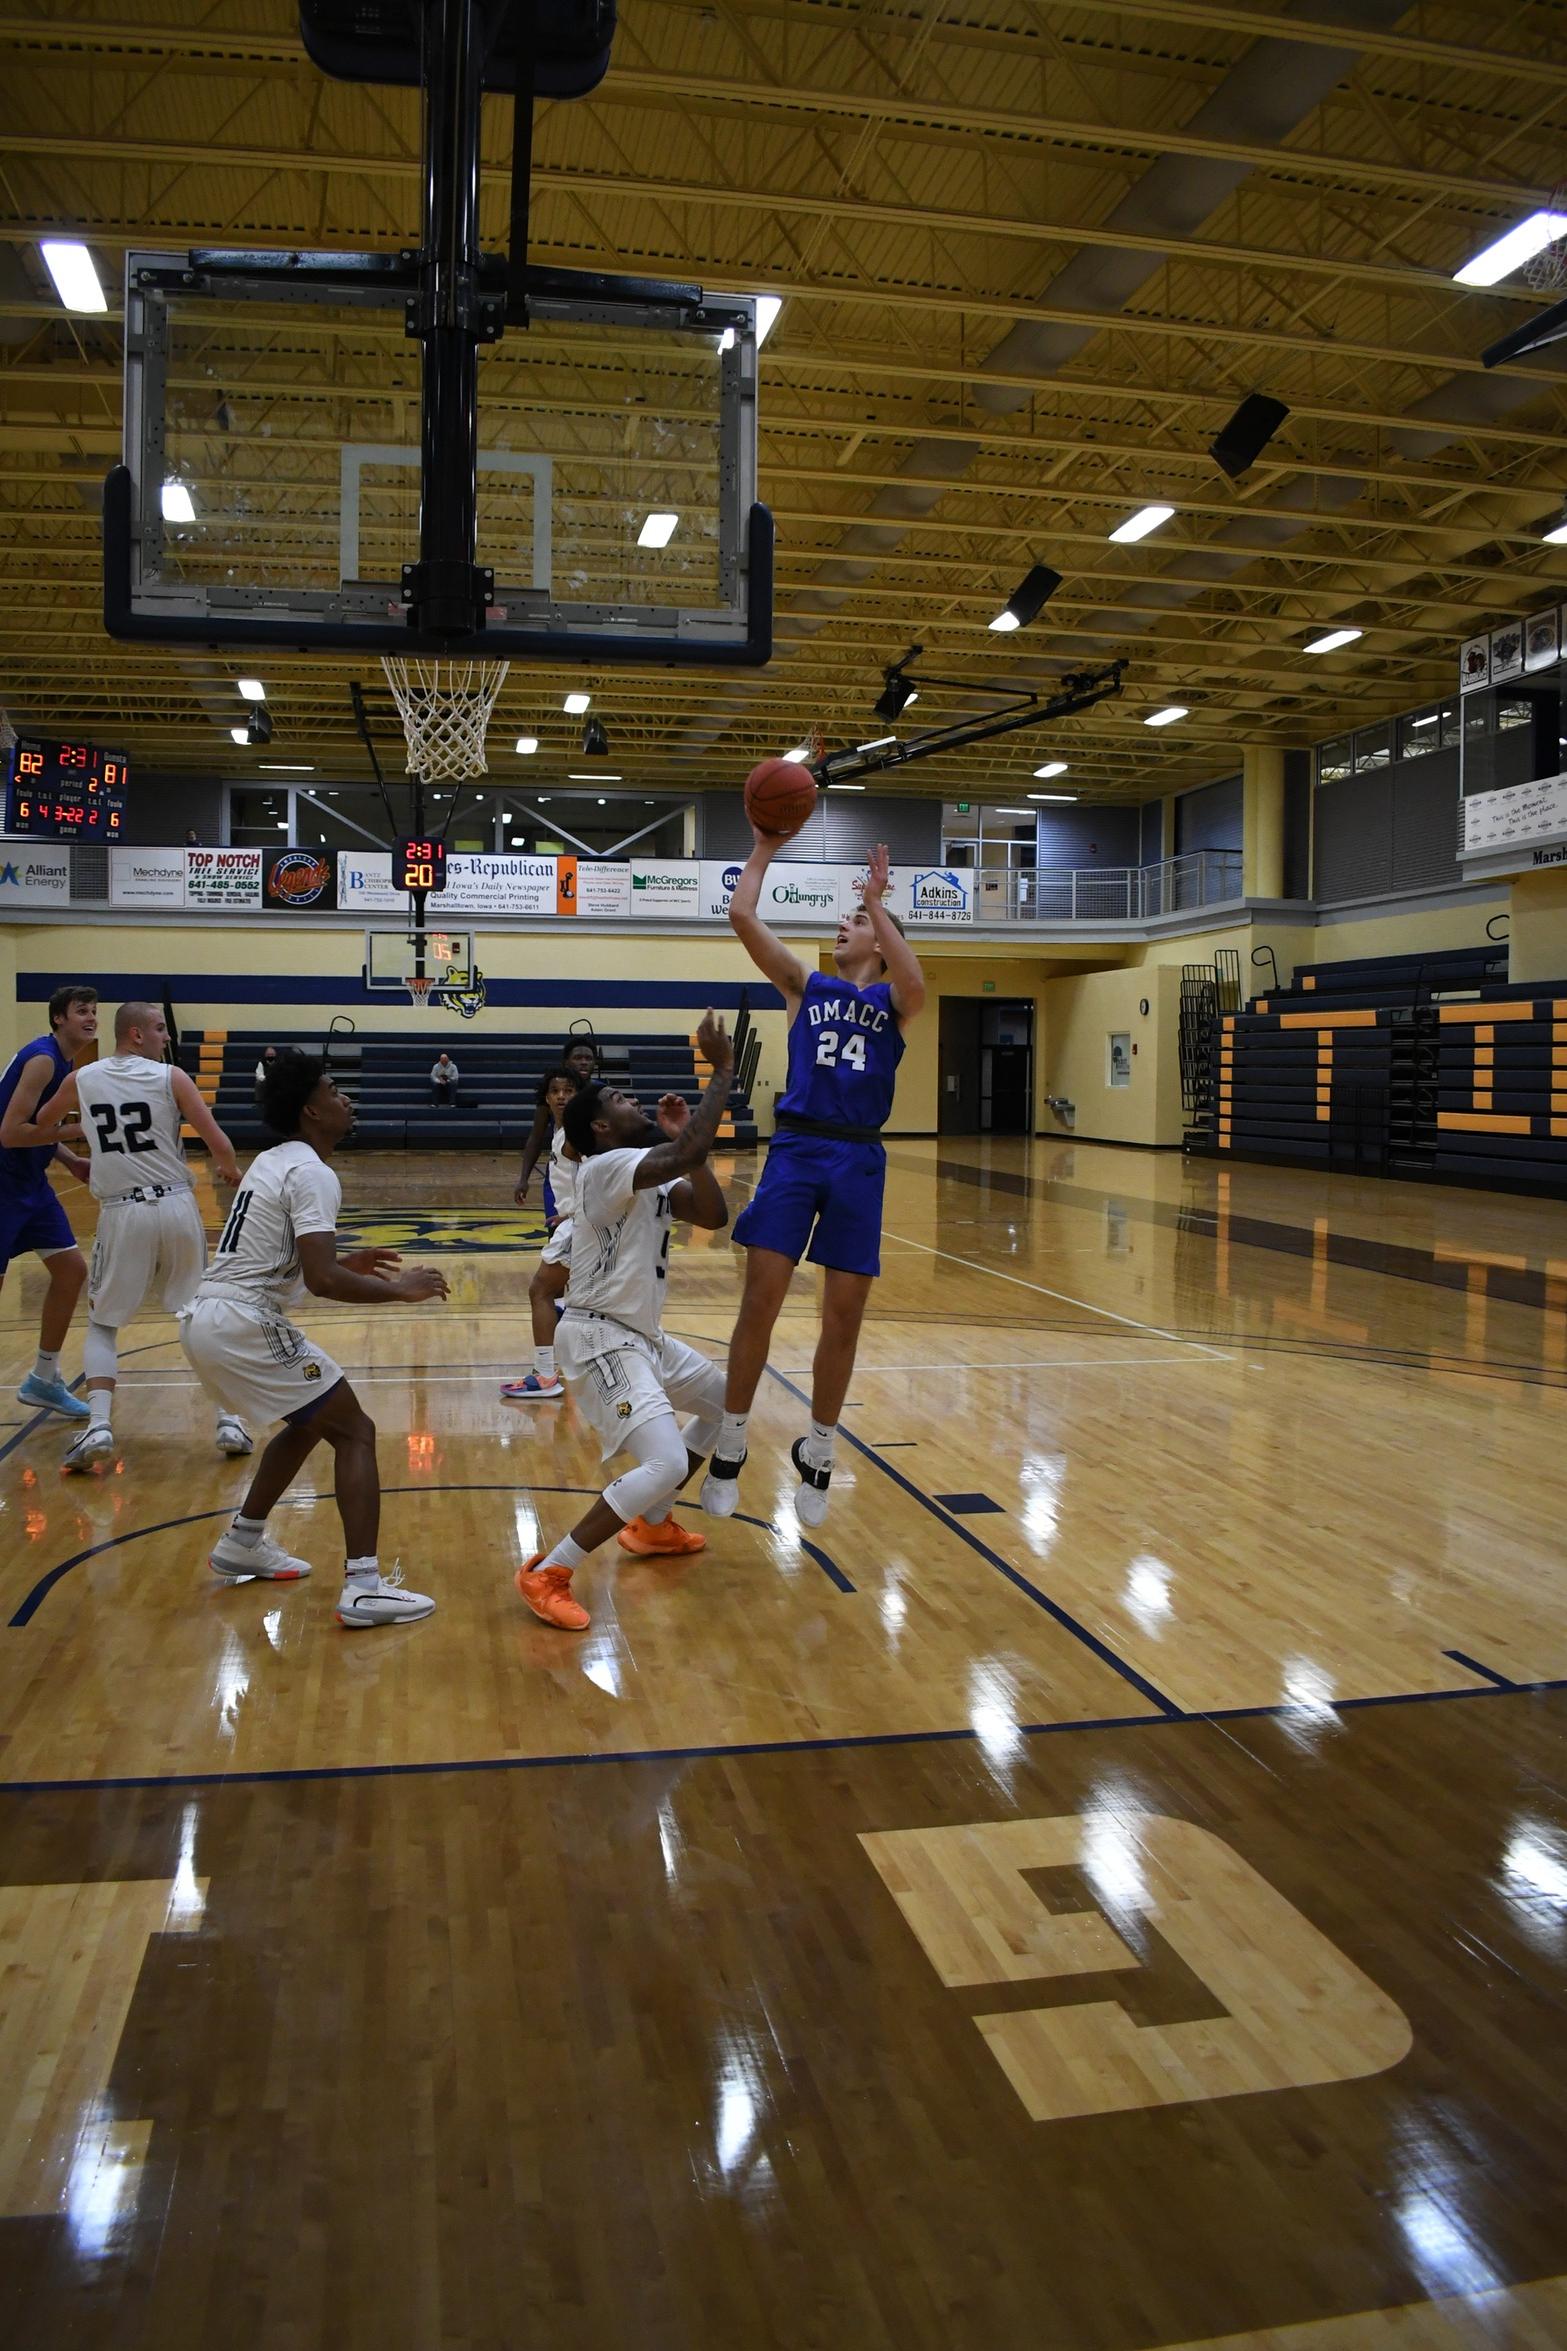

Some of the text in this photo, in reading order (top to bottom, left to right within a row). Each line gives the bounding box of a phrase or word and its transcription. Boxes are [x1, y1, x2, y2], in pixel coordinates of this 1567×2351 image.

[20, 752, 44, 775] 82
[58, 744, 98, 768] 2:31
[104, 763, 128, 785] 81
[88, 777, 98, 793] 2
[19, 802, 30, 818] 6
[39, 804, 48, 818] 4
[88, 810, 99, 825] 2
[110, 812, 120, 827] 6
[406, 842, 443, 860] 2:31
[188, 853, 260, 868] TOP NOTCH
[26, 865, 67, 876] Alliant
[134, 868, 183, 877] Mechdyne
[405, 864, 433, 887] 20
[448, 858, 554, 880] es-Republican
[26, 876, 66, 888] Energy
[188, 880, 260, 889] 641-485-0552
[452, 882, 478, 890] Iowa's
[481, 882, 504, 892] Daily
[507, 883, 550, 893] Newspaper
[648, 875, 698, 886] McGregors
[509, 894, 539, 902] Printing
[921, 887, 958, 899] Adkins
[908, 910, 971, 920] 641-844-8726
[808, 999, 889, 1033] DMACC
[816, 1030, 866, 1071] 24
[90, 1101, 159, 1154] 22
[220, 1191, 254, 1253] 11
